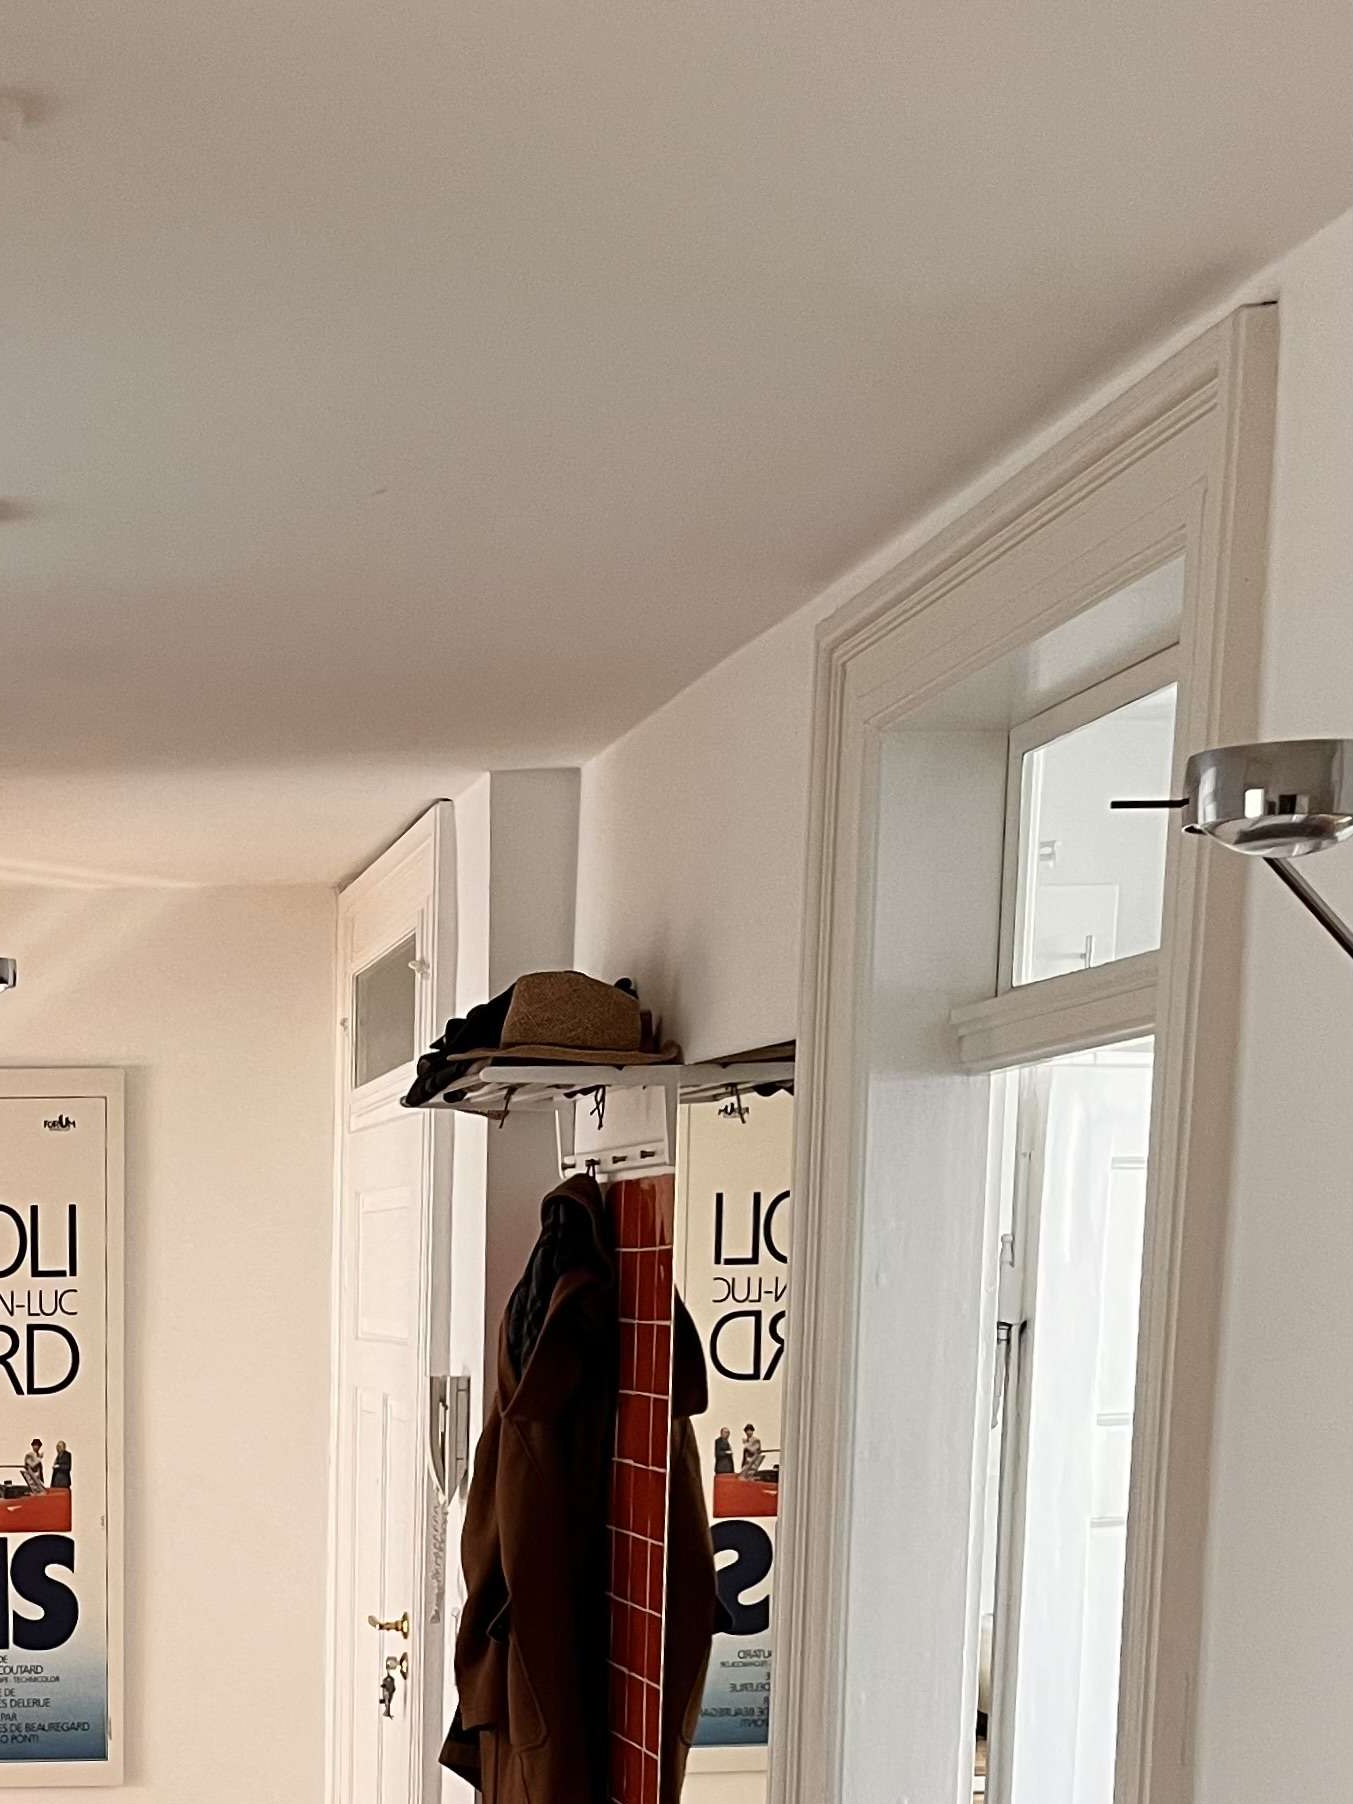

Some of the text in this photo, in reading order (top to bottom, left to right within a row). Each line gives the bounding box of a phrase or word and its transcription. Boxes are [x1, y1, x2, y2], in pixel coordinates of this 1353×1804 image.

[4, 1688, 16, 1697] DE
[10, 1698, 51, 1708] DELERUE
[0, 1712, 17, 1721] PAR
[10, 1723, 23, 1733] DE
[24, 1721, 90, 1733] BEAUREGARD
[11, 1733, 39, 1744] PONTI
